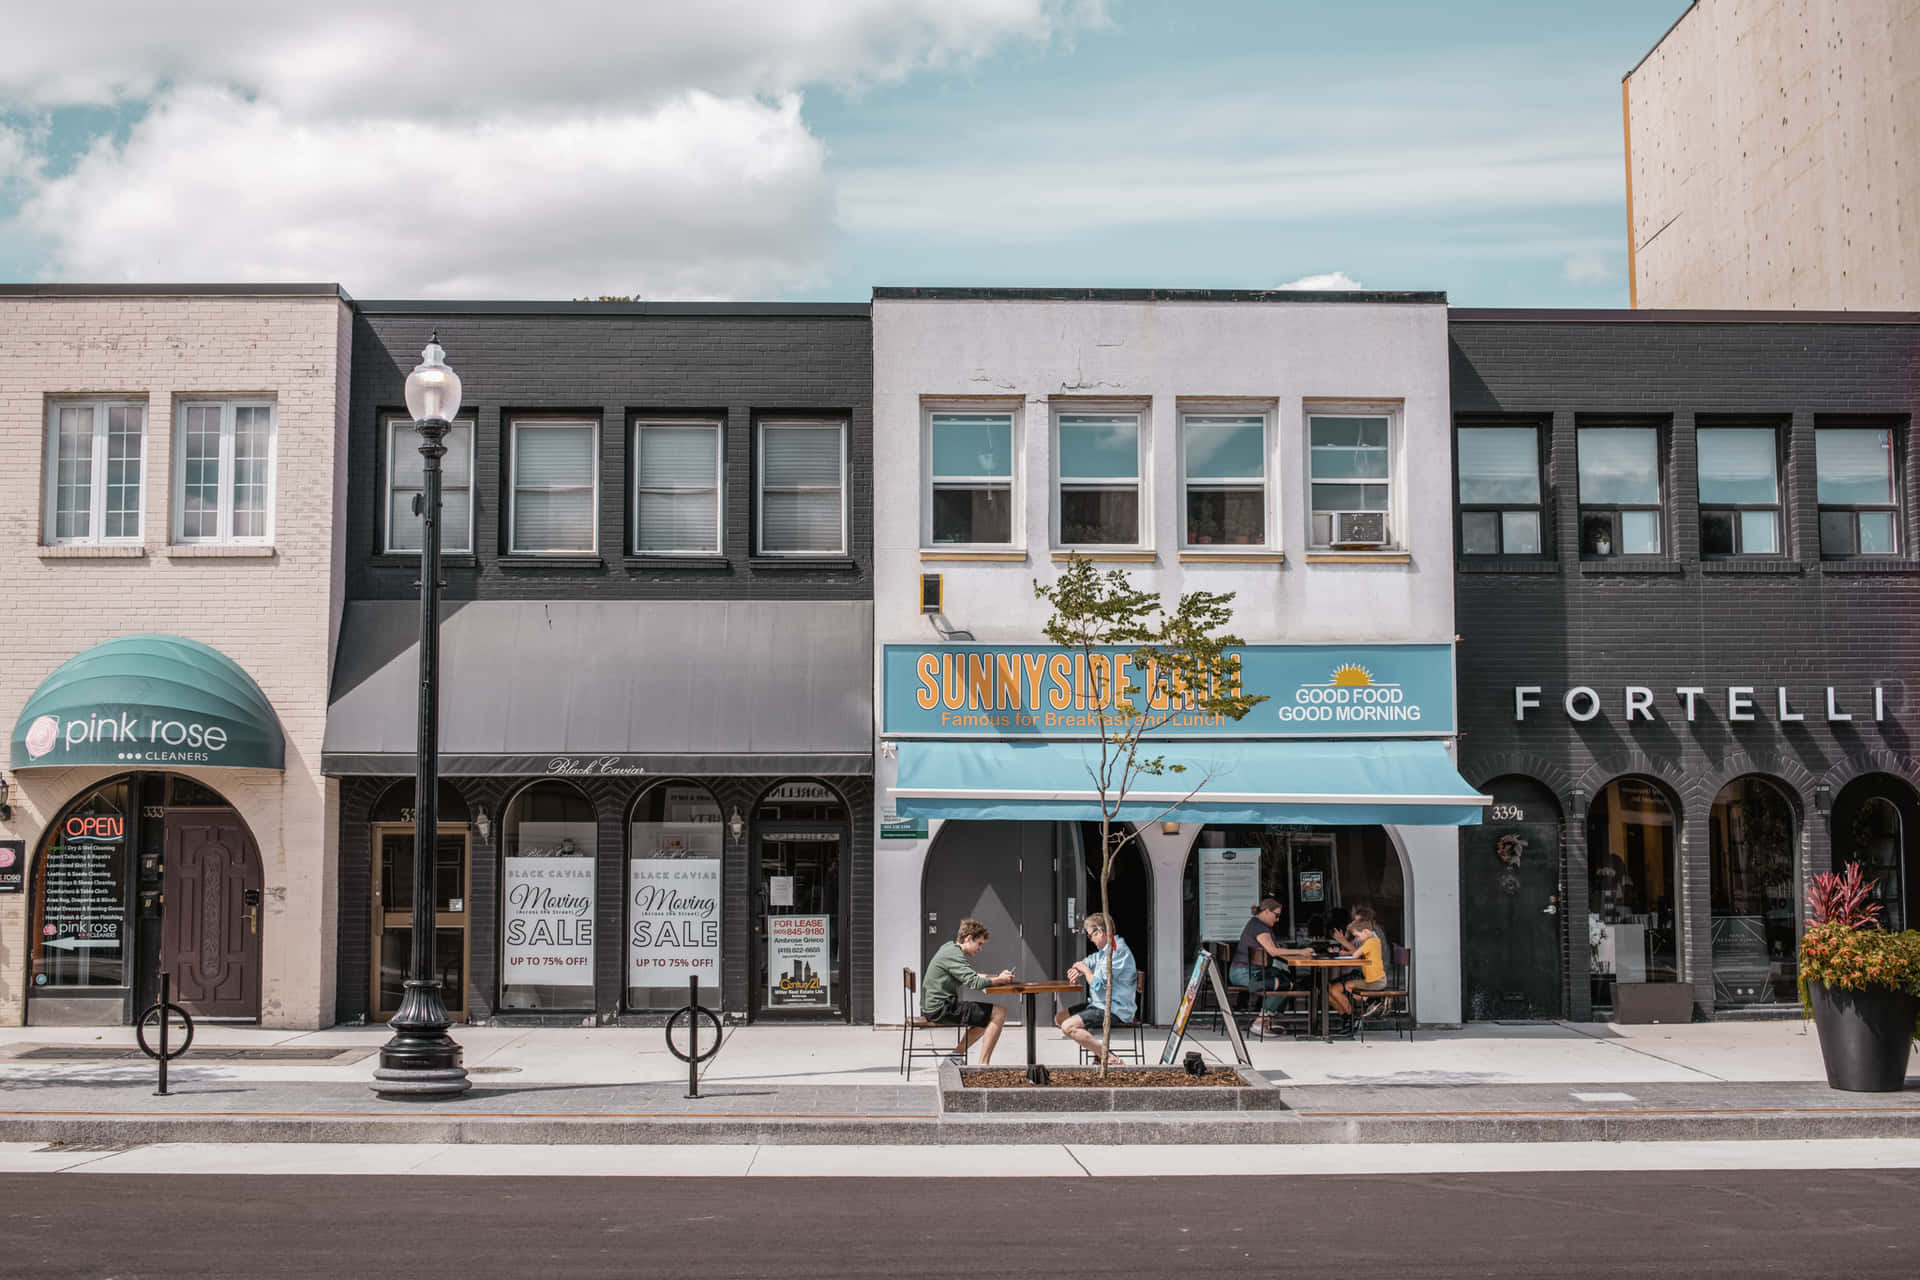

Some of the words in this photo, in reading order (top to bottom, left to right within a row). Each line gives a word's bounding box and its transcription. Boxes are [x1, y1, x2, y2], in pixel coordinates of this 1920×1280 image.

[915, 653, 1133, 711] SUNNYSIDE
[1296, 688, 1350, 703] GOOD
[1353, 688, 1403, 703] FOOD
[1515, 686, 1884, 721] FORTELLI
[941, 712, 1010, 727] Famous
[1015, 712, 1037, 727] for
[1045, 712, 1129, 727] Breakfast
[1134, 712, 1167, 727] and
[1172, 712, 1226, 727] Lunch
[1279, 706, 1333, 721] GOOD
[1336, 705, 1421, 721] MORNING
[66, 711, 138, 751] pink
[150, 719, 228, 751] rose
[145, 752, 209, 762] CLEANERS
[546, 757, 598, 775] Black
[599, 756, 645, 775] Caviar
[143, 805, 164, 819] 333
[66, 817, 124, 836] OPEN
[508, 870, 544, 878] BLACK
[548, 870, 592, 878] CAVIAR
[509, 883, 592, 917] Moving
[634, 885, 717, 918] Moving
[59, 920, 87, 936] pink
[89, 923, 117, 933] rose
[774, 919, 792, 928] FOR
[794, 919, 823, 928] LEASE
[506, 918, 592, 946] SALE
[632, 920, 718, 947] SALE
[510, 957, 524, 966] UP
[526, 957, 540, 966] TO
[542, 957, 563, 966] 75%
[565, 957, 588, 966] OFF!
[636, 959, 650, 967] UP
[652, 959, 666, 967] TO
[669, 959, 689, 967] 75%
[691, 959, 714, 967] OFF!
